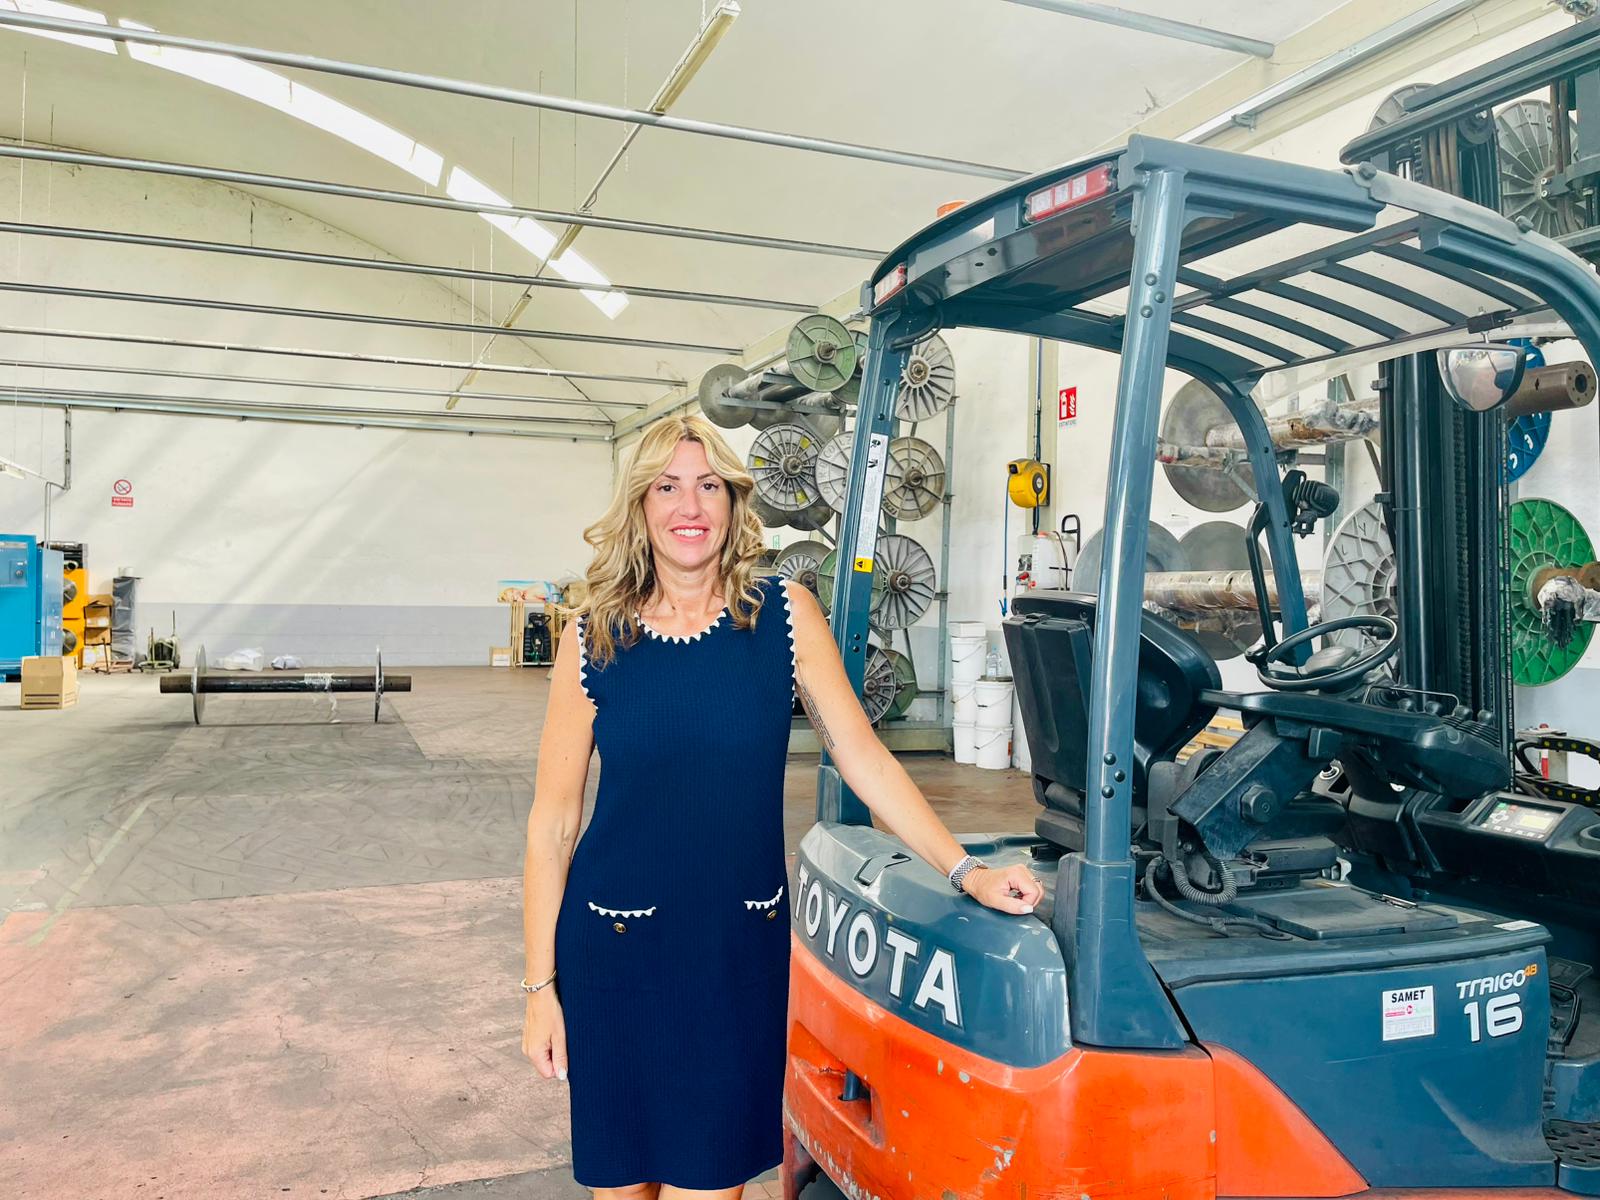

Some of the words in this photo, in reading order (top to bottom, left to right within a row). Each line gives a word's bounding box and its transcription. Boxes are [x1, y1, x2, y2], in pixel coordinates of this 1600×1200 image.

[794, 863, 962, 1027] TOYOTA
[1391, 989, 1426, 1004] SAMET
[1463, 992, 1523, 1043] 16
